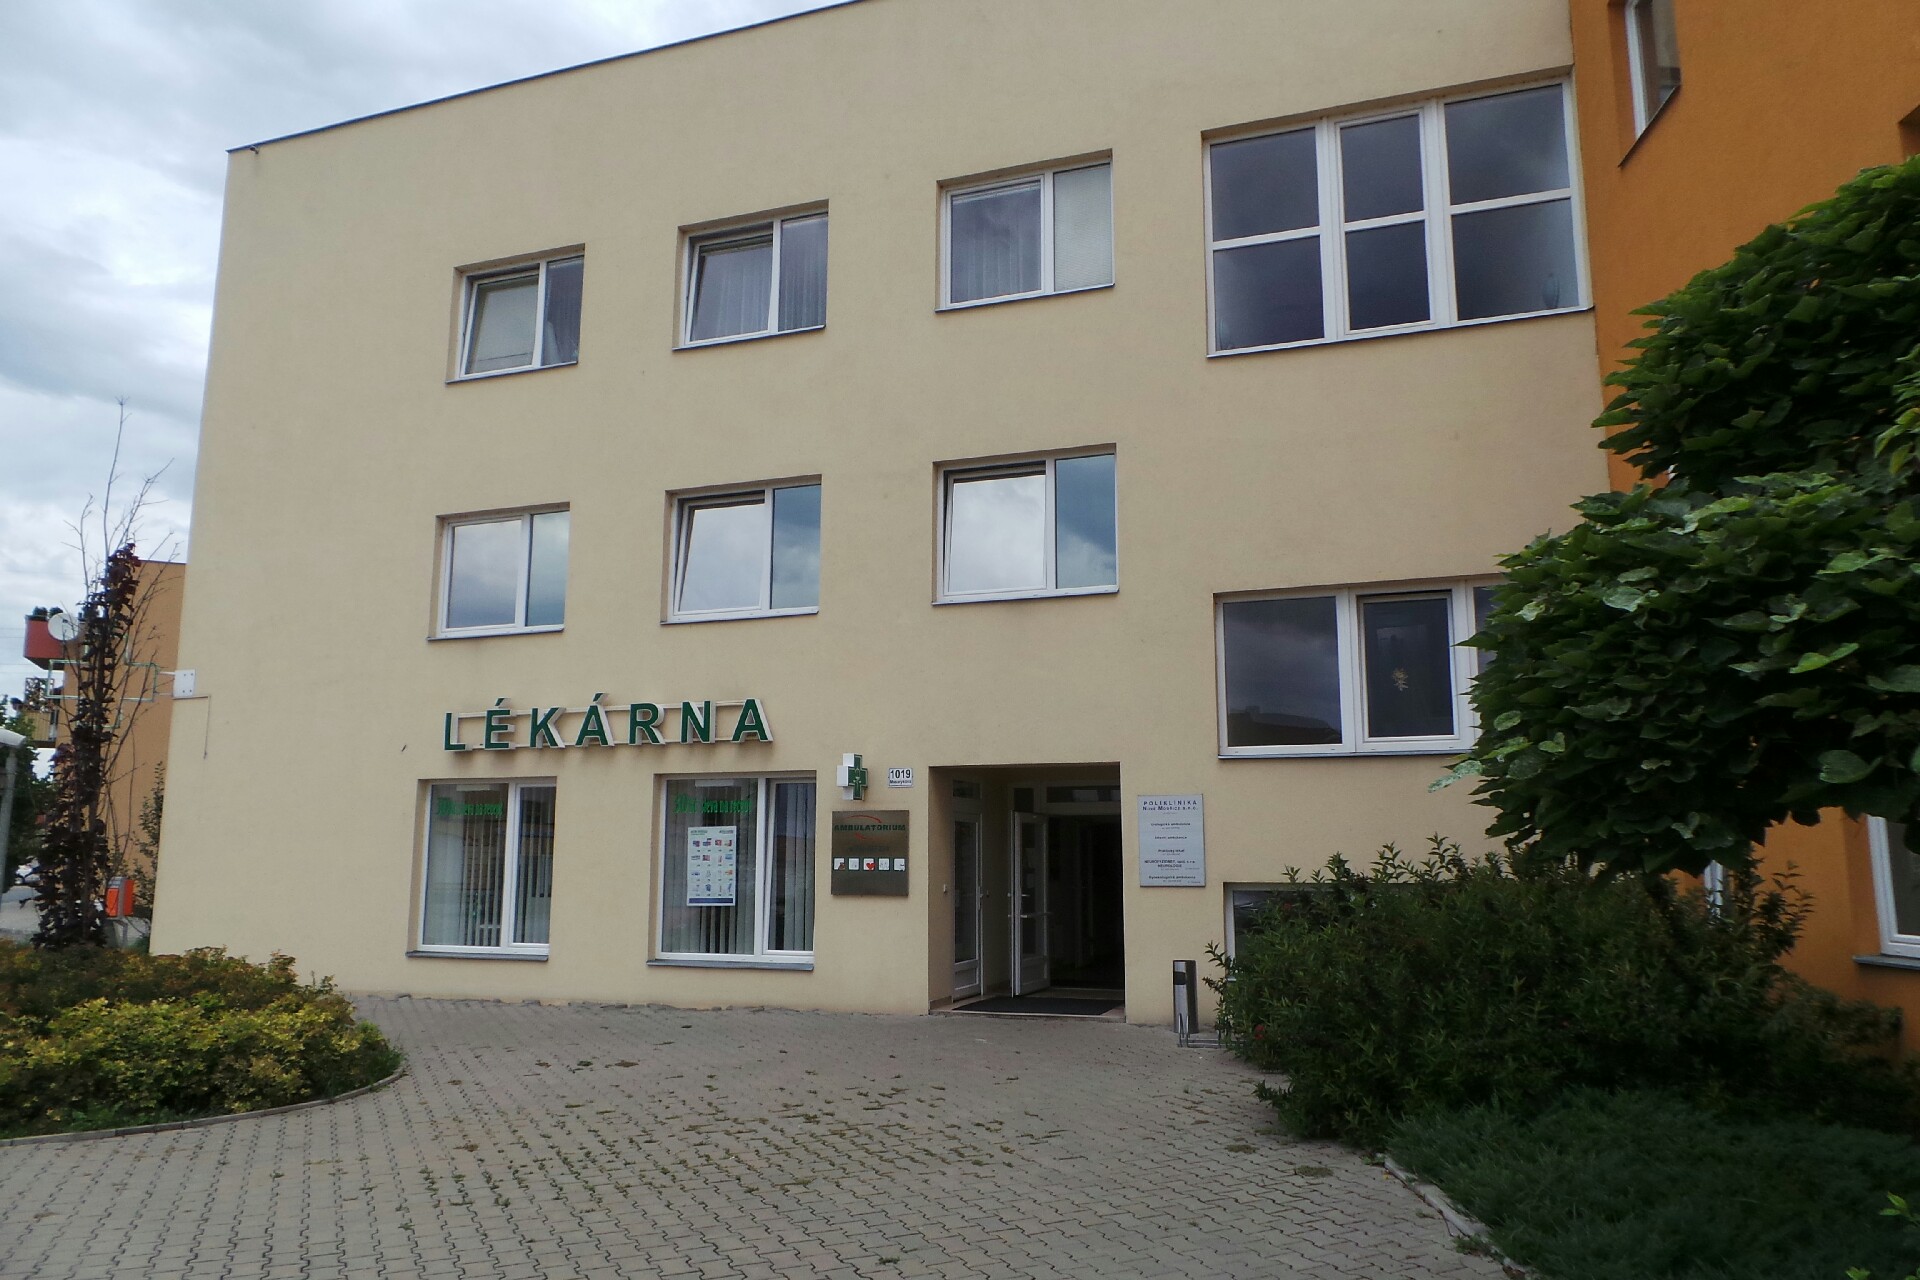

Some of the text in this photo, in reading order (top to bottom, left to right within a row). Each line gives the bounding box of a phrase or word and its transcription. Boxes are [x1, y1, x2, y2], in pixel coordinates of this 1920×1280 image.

[443, 692, 773, 751] LÉKÁRNA
[890, 769, 911, 779] 1019
[834, 824, 906, 832] AMBULATORIUM
